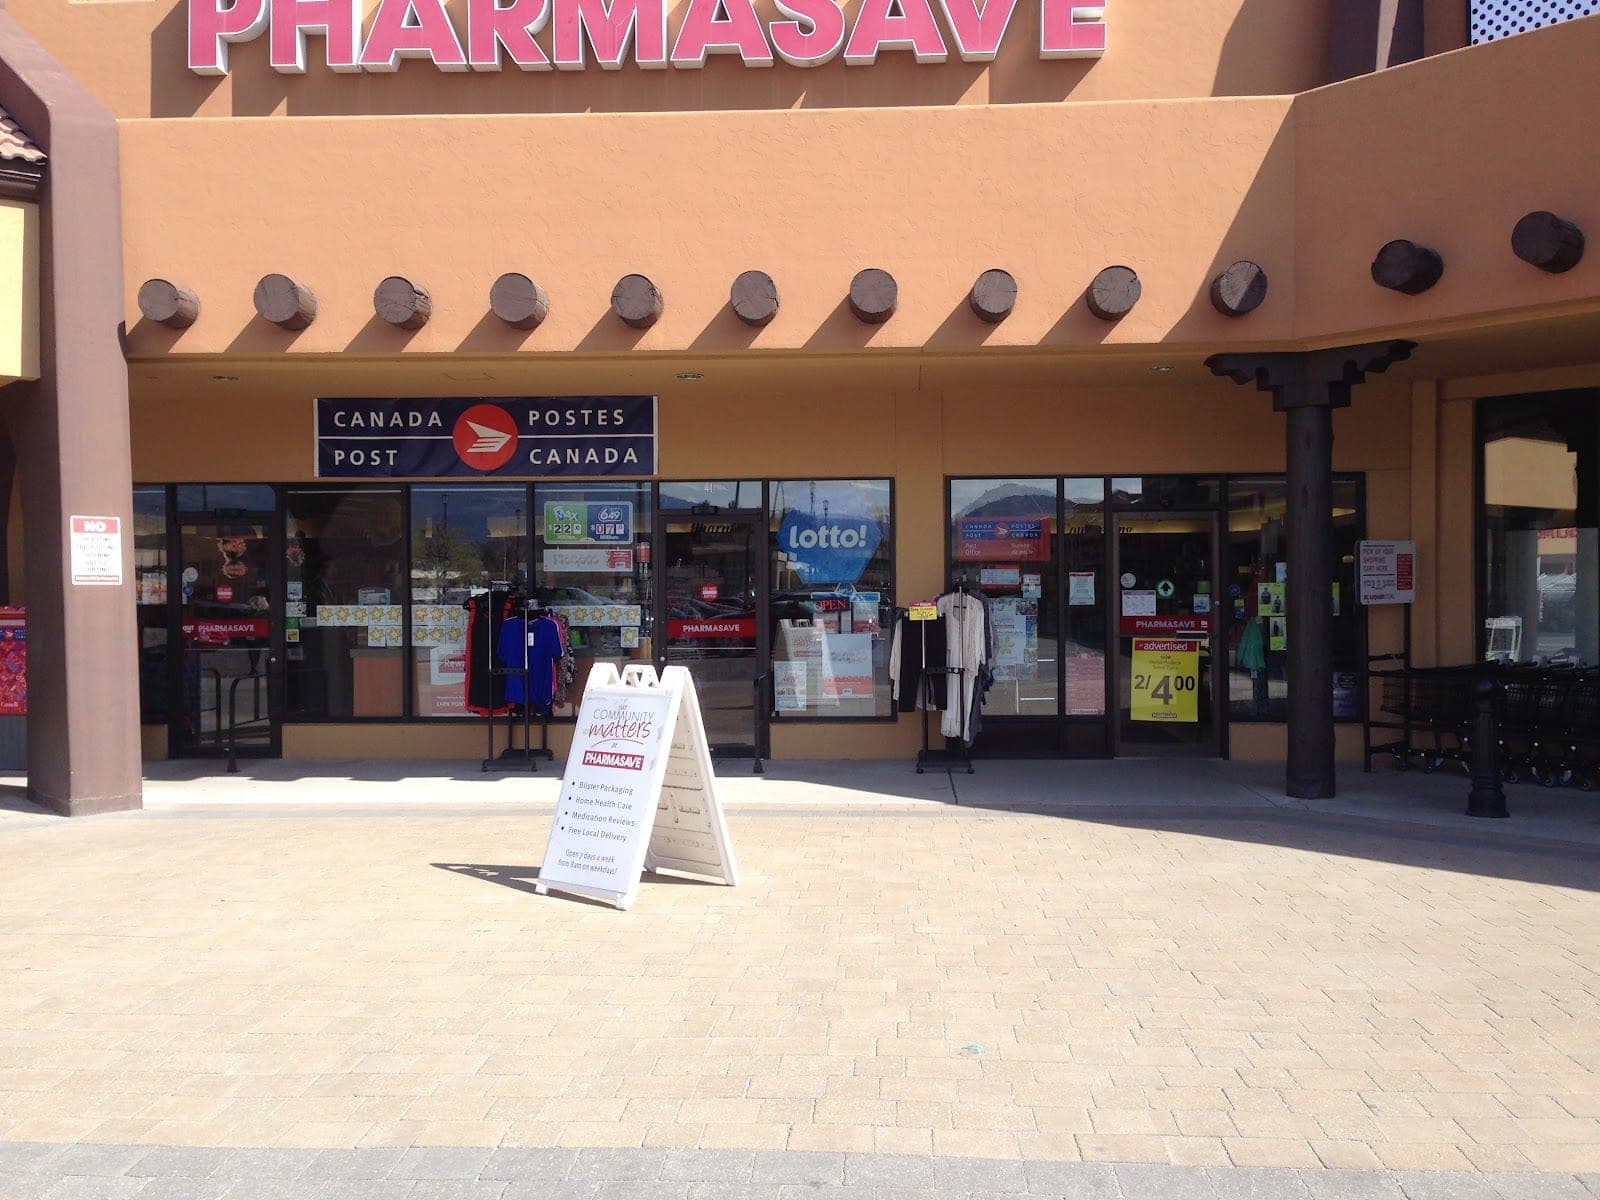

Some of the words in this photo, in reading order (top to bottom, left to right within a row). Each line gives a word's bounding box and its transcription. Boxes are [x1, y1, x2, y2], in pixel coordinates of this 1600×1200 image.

[187, 0, 1106, 75] PHARMASAVE
[334, 411, 442, 428] CANADA
[528, 409, 624, 426] POSTES
[334, 450, 398, 466] POST
[529, 447, 638, 465] CANADA
[84, 521, 105, 532] NO
[789, 524, 867, 549] lotto!
[814, 600, 847, 610] OPEN
[198, 624, 255, 632] PHARMASAVE
[682, 624, 740, 633] PHARMASAVE
[1143, 641, 1188, 651] advertised
[593, 709, 655, 721] COMMUNITY
[588, 719, 652, 738] matters
[584, 752, 642, 769] PHARMASAVE
[600, 783, 634, 796] Packaging
[575, 796, 594, 806] Home
[594, 798, 616, 808] Health
[571, 811, 607, 823] Medication
[608, 815, 635, 827] Reviews
[568, 826, 582, 835] Free
[582, 829, 600, 838] Local
[600, 830, 627, 843] Delivery
